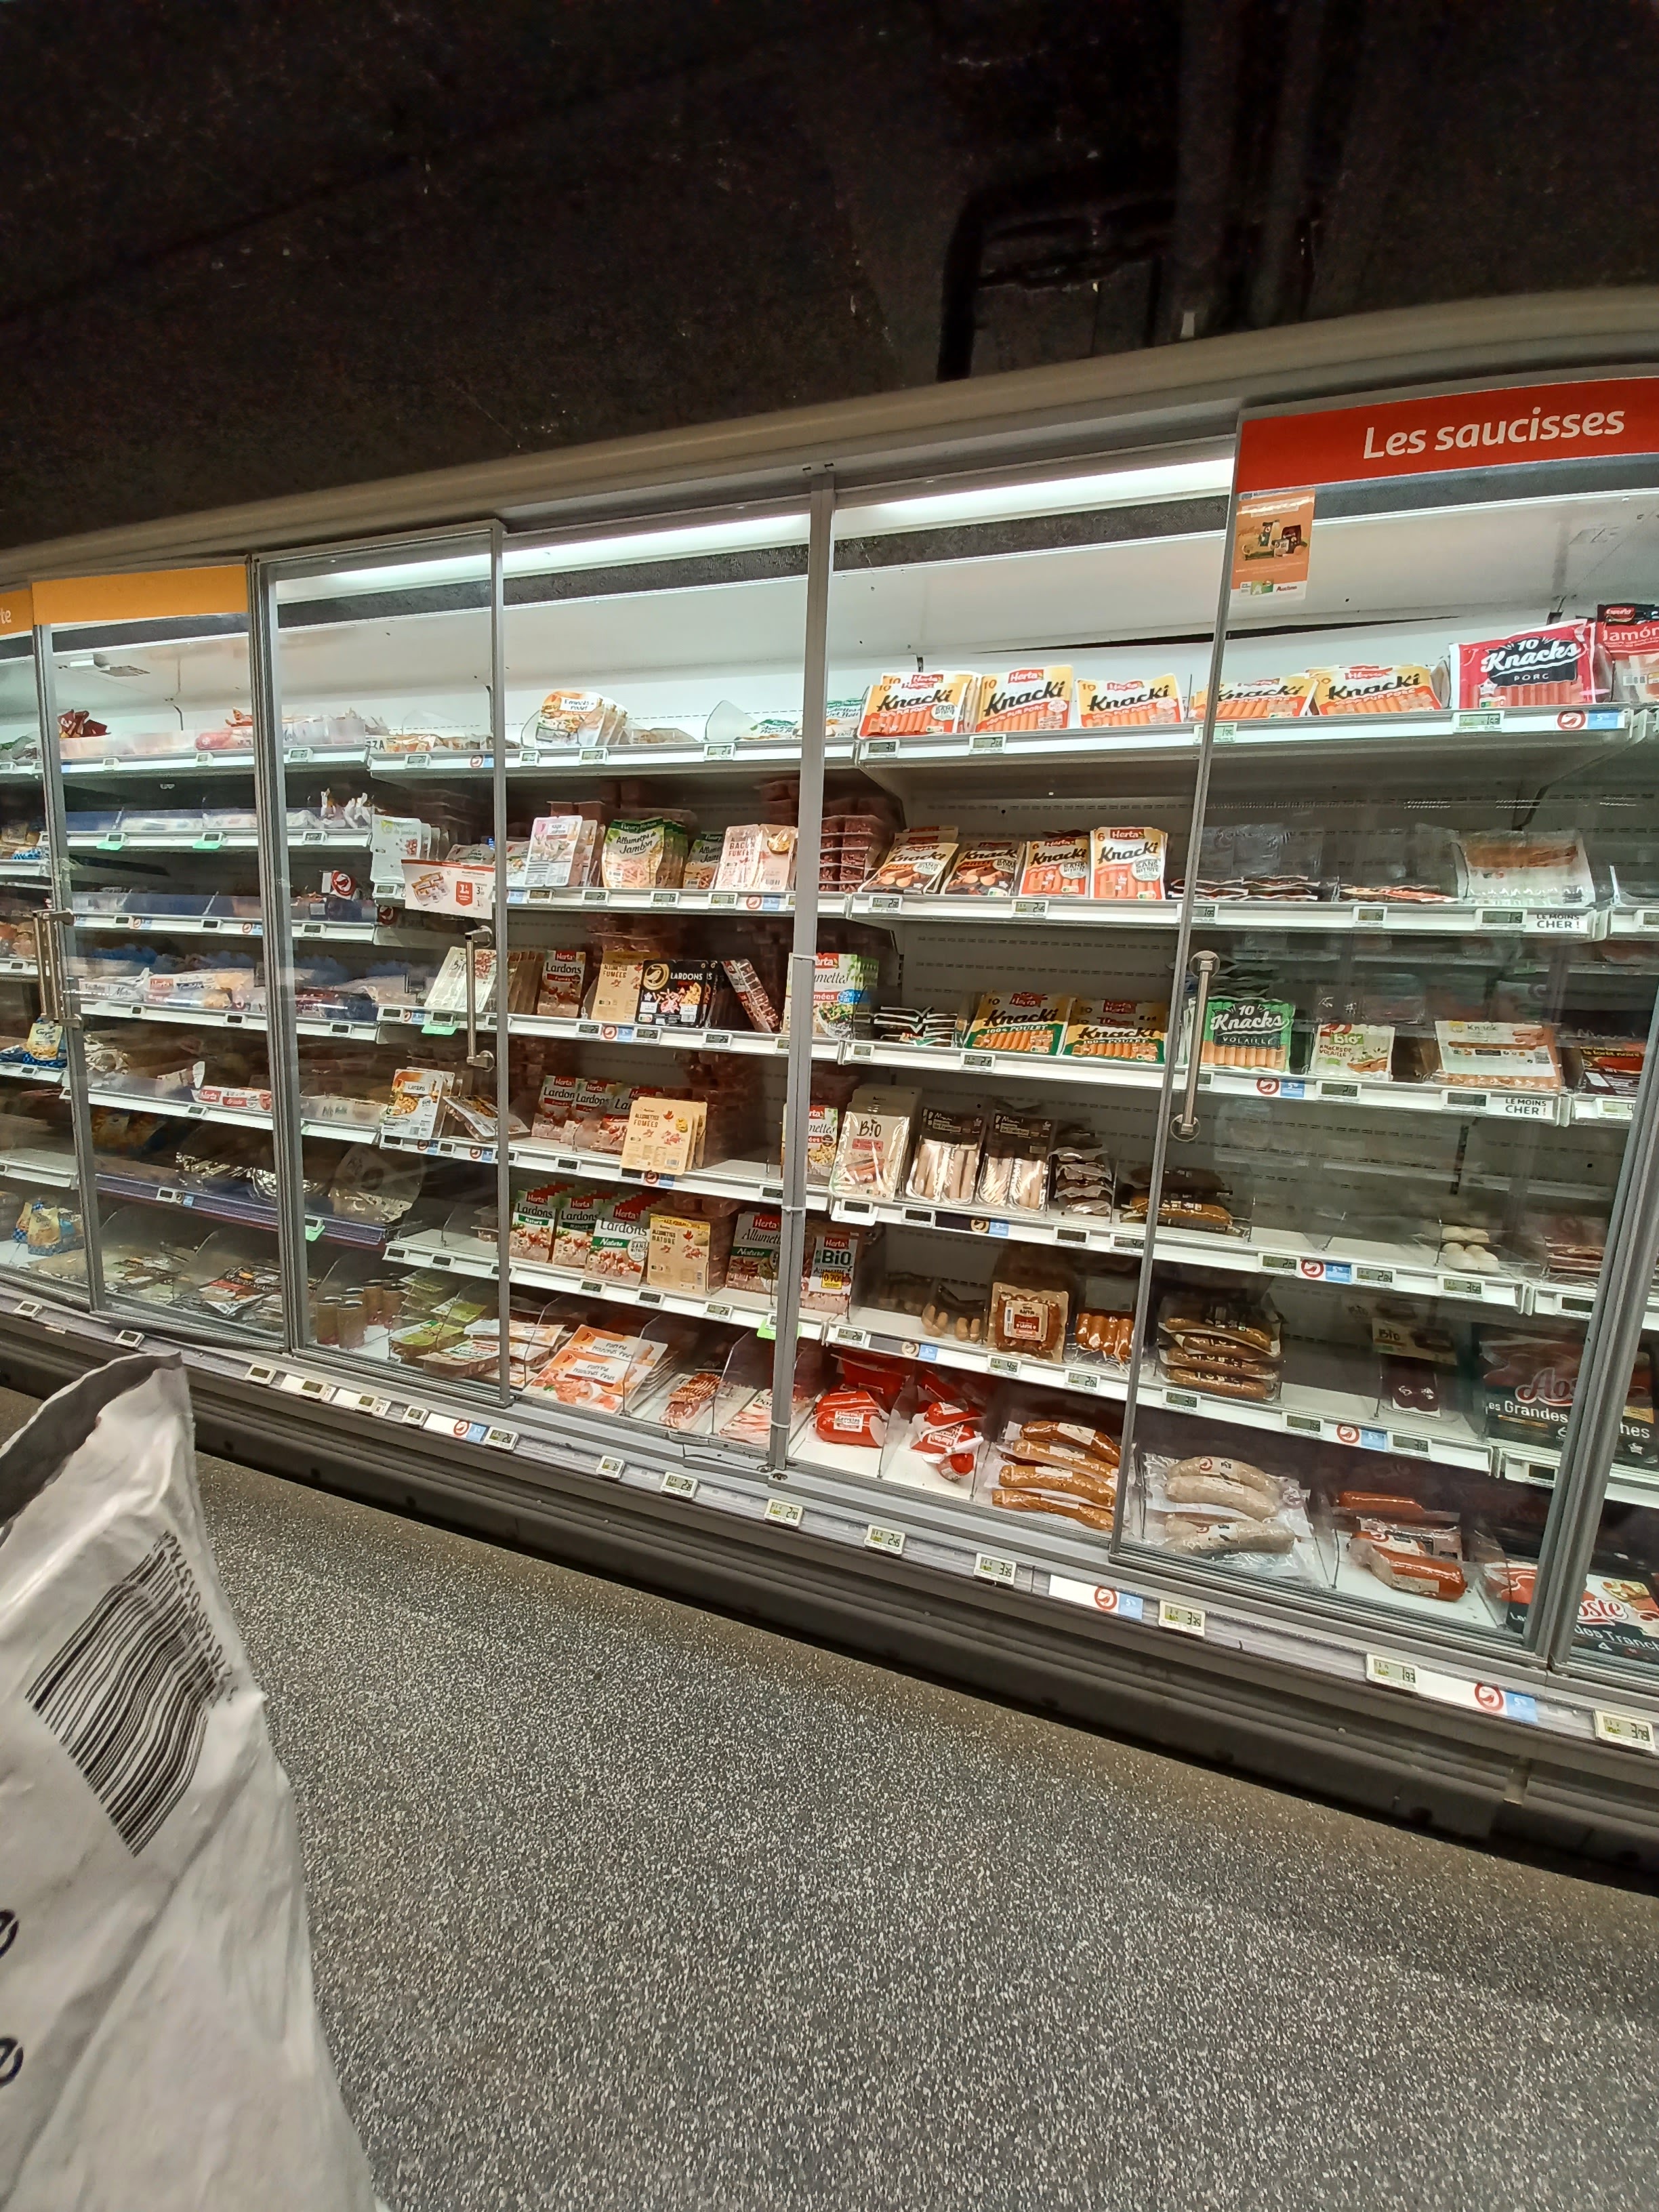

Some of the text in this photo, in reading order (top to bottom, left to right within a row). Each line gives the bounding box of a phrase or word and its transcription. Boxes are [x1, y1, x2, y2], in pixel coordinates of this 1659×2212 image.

[1364, 407, 1625, 459] Les saucisses
[1517, 639, 1536, 651] 10
[1481, 642, 1582, 672] Knacks
[1009, 671, 1038, 682] Herta
[1514, 673, 1550, 682] PORC
[984, 680, 997, 689] 10
[1328, 673, 1420, 700] Knacki
[984, 681, 1065, 716] Knacki
[1088, 685, 1169, 711] Knacki
[1217, 685, 1303, 702] Knacki
[877, 689, 953, 712] Knacki
[1007, 709, 1022, 717] PUR
[1023, 704, 1045, 714] PORC
[617, 834, 650, 844] Allumettes
[1097, 833, 1105, 841] 6
[1112, 830, 1139, 838] Herta
[619, 840, 653, 855] Jambon
[1098, 841, 1159, 864] Knacki
[891, 851, 946, 861] Knacki
[960, 848, 1017, 861] Knack
[1030, 848, 1086, 865] Knacki
[1537, 920, 1573, 929] CHER
[815, 957, 834, 966] erta
[546, 962, 581, 975] Lardons
[670, 972, 703, 981] LARDONS
[1238, 1005, 1255, 1015] 10
[983, 1008, 1059, 1027] Knacki
[1210, 1012, 1290, 1031] Knacks
[1008, 1024, 1048, 1032] POULET
[1078, 1027, 1157, 1039] Knacki
[1222, 1036, 1273, 1046] VOLAILLE
[1334, 1034, 1361, 1044] bio
[555, 1078, 573, 1086] Herta
[544, 1086, 575, 1099] Lardon
[1517, 1099, 1547, 1107] MOINS
[1505, 1105, 1540, 1115] CHER
[517, 1203, 553, 1218] Lardons
[561, 1210, 599, 1221] Lardons
[615, 1209, 636, 1218] Herta
[600, 1218, 647, 1236] Lardons
[755, 1218, 777, 1228] Herta
[600, 1238, 623, 1247] Nature
[652, 1235, 676, 1245] NATURE
[737, 1248, 766, 1257] Nature
[1504, 1400, 1568, 1422] Grandes
[1578, 1599, 1622, 1618] oste
